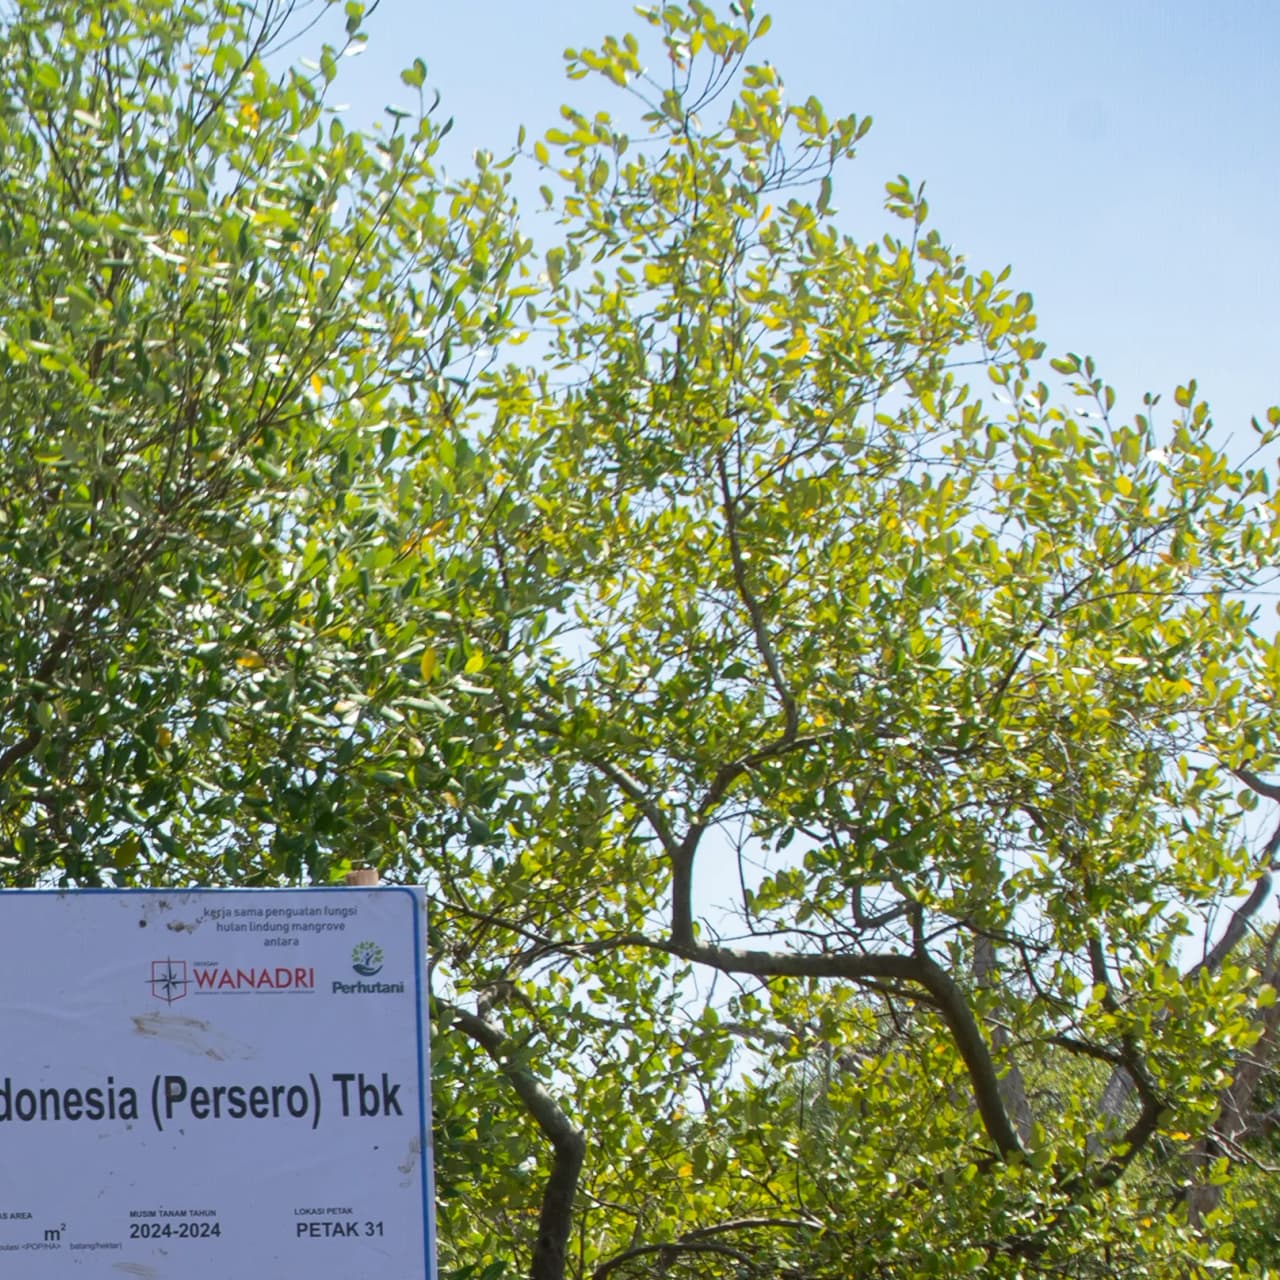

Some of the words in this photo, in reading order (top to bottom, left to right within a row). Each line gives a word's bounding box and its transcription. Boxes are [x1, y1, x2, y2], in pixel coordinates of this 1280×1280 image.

[203, 906, 232, 919] kerja
[234, 908, 263, 917] sama
[265, 907, 322, 920] penguatan
[324, 906, 357, 919] fungsi
[216, 922, 248, 932] hutan
[249, 922, 290, 934] lindung
[291, 922, 345, 934] mangrove
[263, 936, 299, 947] antara
[193, 967, 314, 989] WANADRI
[332, 980, 405, 995] Perhutani
[152, 1073, 320, 1131] (Persero)
[333, 1073, 403, 1117] Tbk
[10, 1212, 33, 1220] AREA
[129, 1210, 157, 1218] MUSIM
[159, 1210, 188, 1218] TANAM
[189, 1209, 217, 1217] TAHUN
[294, 1208, 325, 1216] LOKASI
[326, 1207, 353, 1215] PETAK
[129, 1222, 222, 1239] 2024-2024
[296, 1221, 360, 1238] PETAK
[364, 1221, 385, 1237] 31
